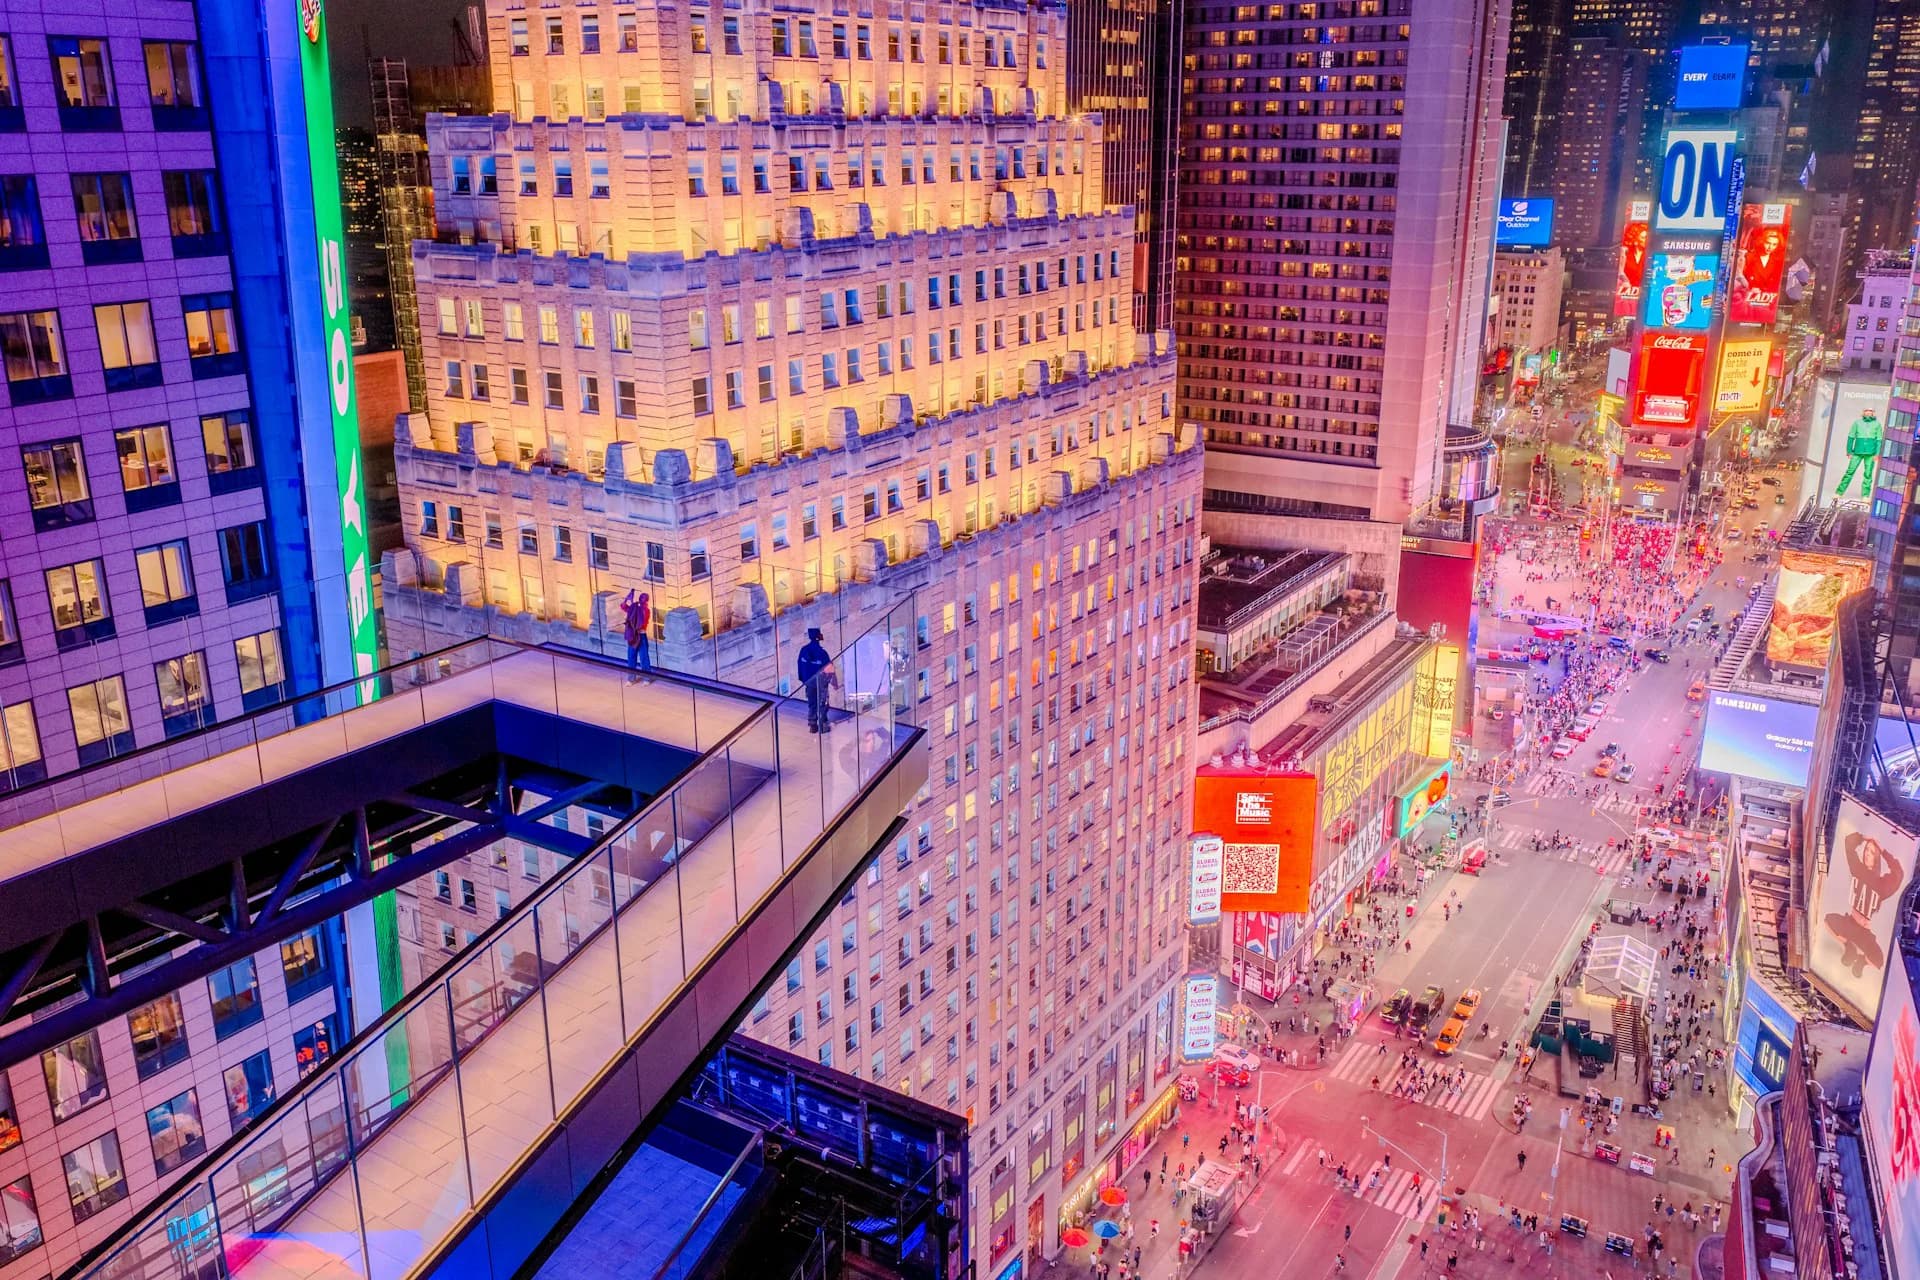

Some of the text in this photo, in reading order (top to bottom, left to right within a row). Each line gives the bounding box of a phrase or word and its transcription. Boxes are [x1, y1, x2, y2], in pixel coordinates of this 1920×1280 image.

[1683, 73, 1708, 81] EVERY
[1661, 140, 1736, 219] ON
[1664, 242, 1711, 250] SAMSUNG
[1746, 292, 1777, 303] LADY
[1752, 348, 1763, 357] in
[343, 448, 373, 704] YEA
[1715, 697, 1767, 712] SAMSUNG
[1241, 793, 1265, 802] Save
[1240, 808, 1270, 816] Music
[1849, 877, 1880, 919] GAP
[1761, 1041, 1785, 1082] GAP
